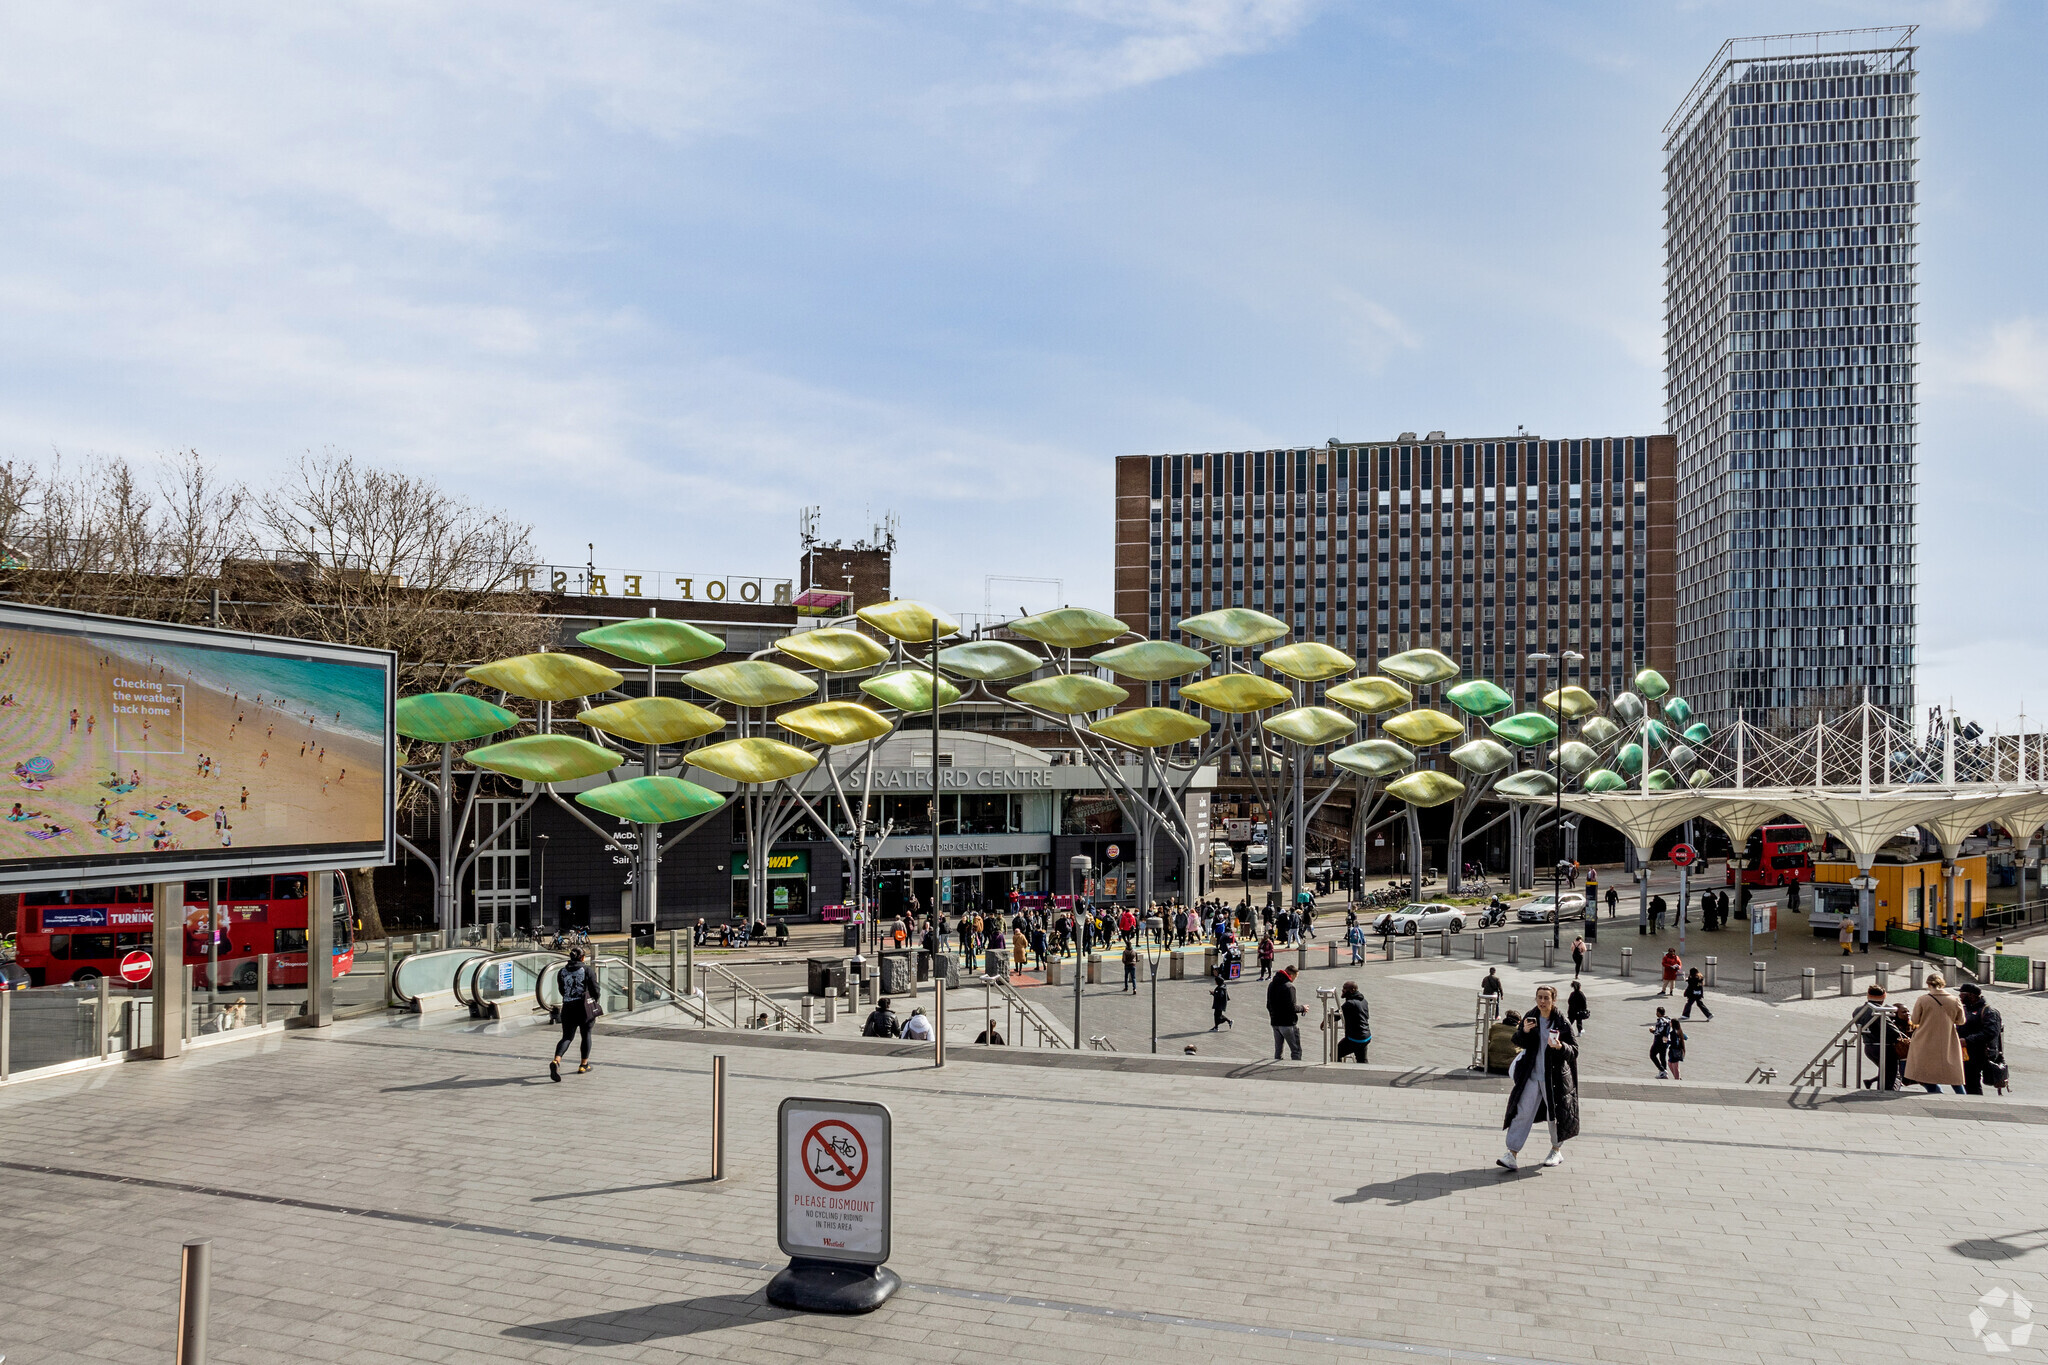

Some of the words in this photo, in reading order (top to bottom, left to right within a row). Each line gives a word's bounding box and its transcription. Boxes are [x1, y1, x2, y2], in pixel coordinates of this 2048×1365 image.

[113, 678, 162, 693] Checking
[113, 691, 131, 701] the
[133, 693, 177, 704] weather
[113, 703, 138, 714] back
[141, 705, 170, 716] home
[977, 769, 1054, 788] CENTRE
[1076, 803, 1118, 818] WHOPPER
[906, 842, 954, 852] STRATORD
[956, 842, 988, 851] CENTRE
[794, 1194, 827, 1208] PLEASE
[829, 1197, 875, 1213] DISMOUNT
[806, 1210, 814, 1218] NO
[815, 1210, 838, 1220] CYCLING
[843, 1213, 863, 1222] RIDING
[823, 1221, 836, 1230] THIS
[837, 1222, 852, 1231] AREA
[823, 1238, 845, 1248] Westfield
